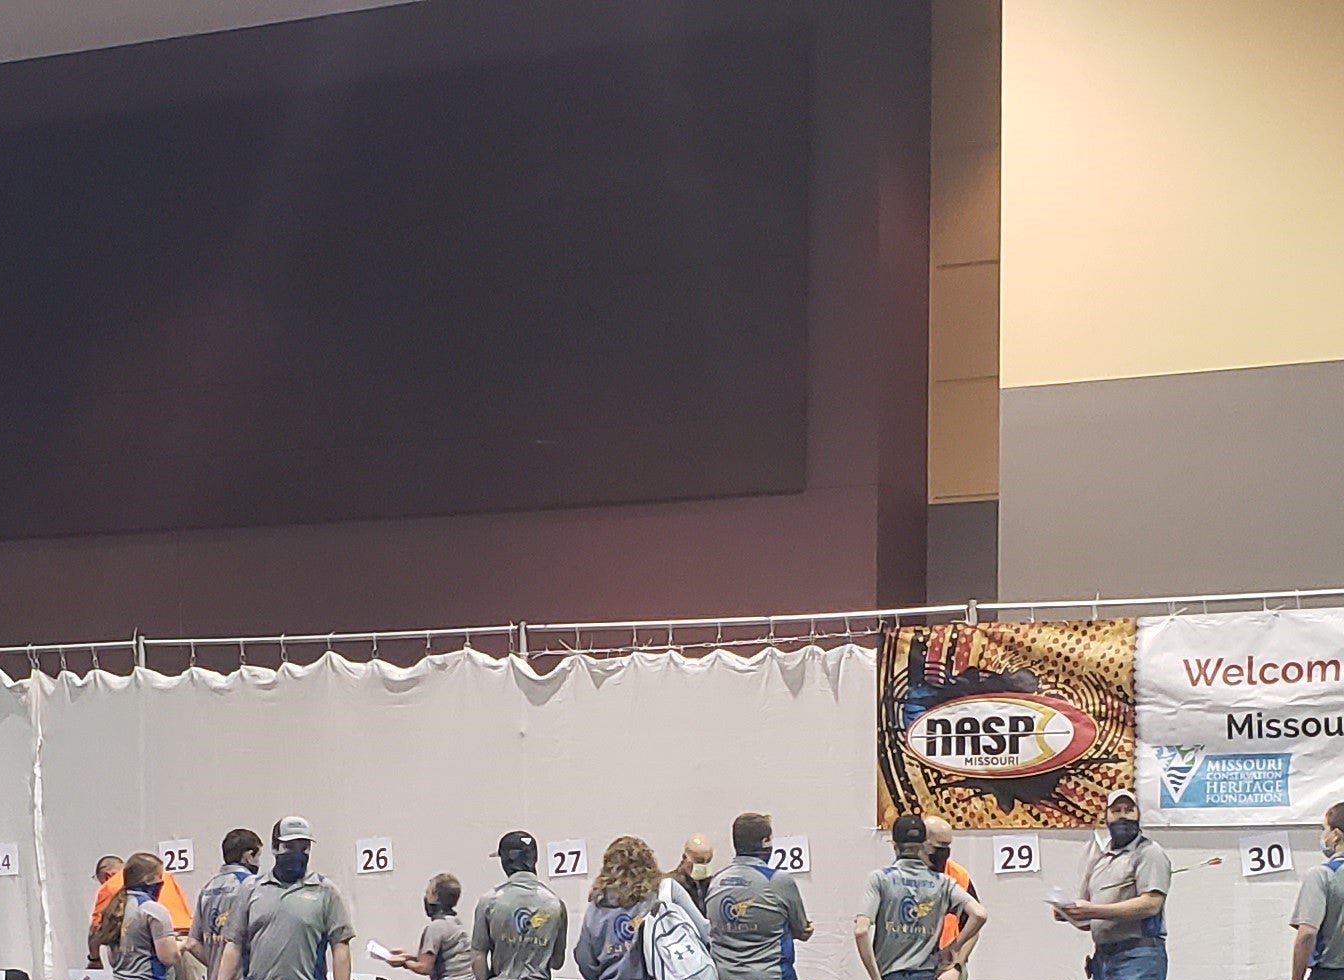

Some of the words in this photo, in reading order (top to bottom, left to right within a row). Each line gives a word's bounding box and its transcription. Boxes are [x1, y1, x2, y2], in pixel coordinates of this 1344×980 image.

[964, 756, 1019, 767] MISSOURI
[1206, 758, 1283, 772] MISSOURI
[1206, 780, 1283, 794] HERITAGE
[1206, 793, 1283, 804] FOUNDATION
[164, 849, 189, 872] 25
[362, 848, 388, 871] 26
[553, 850, 581, 874] 27
[773, 847, 804, 871] 28
[1000, 845, 1033, 870] 29
[1248, 843, 1285, 872] 30
